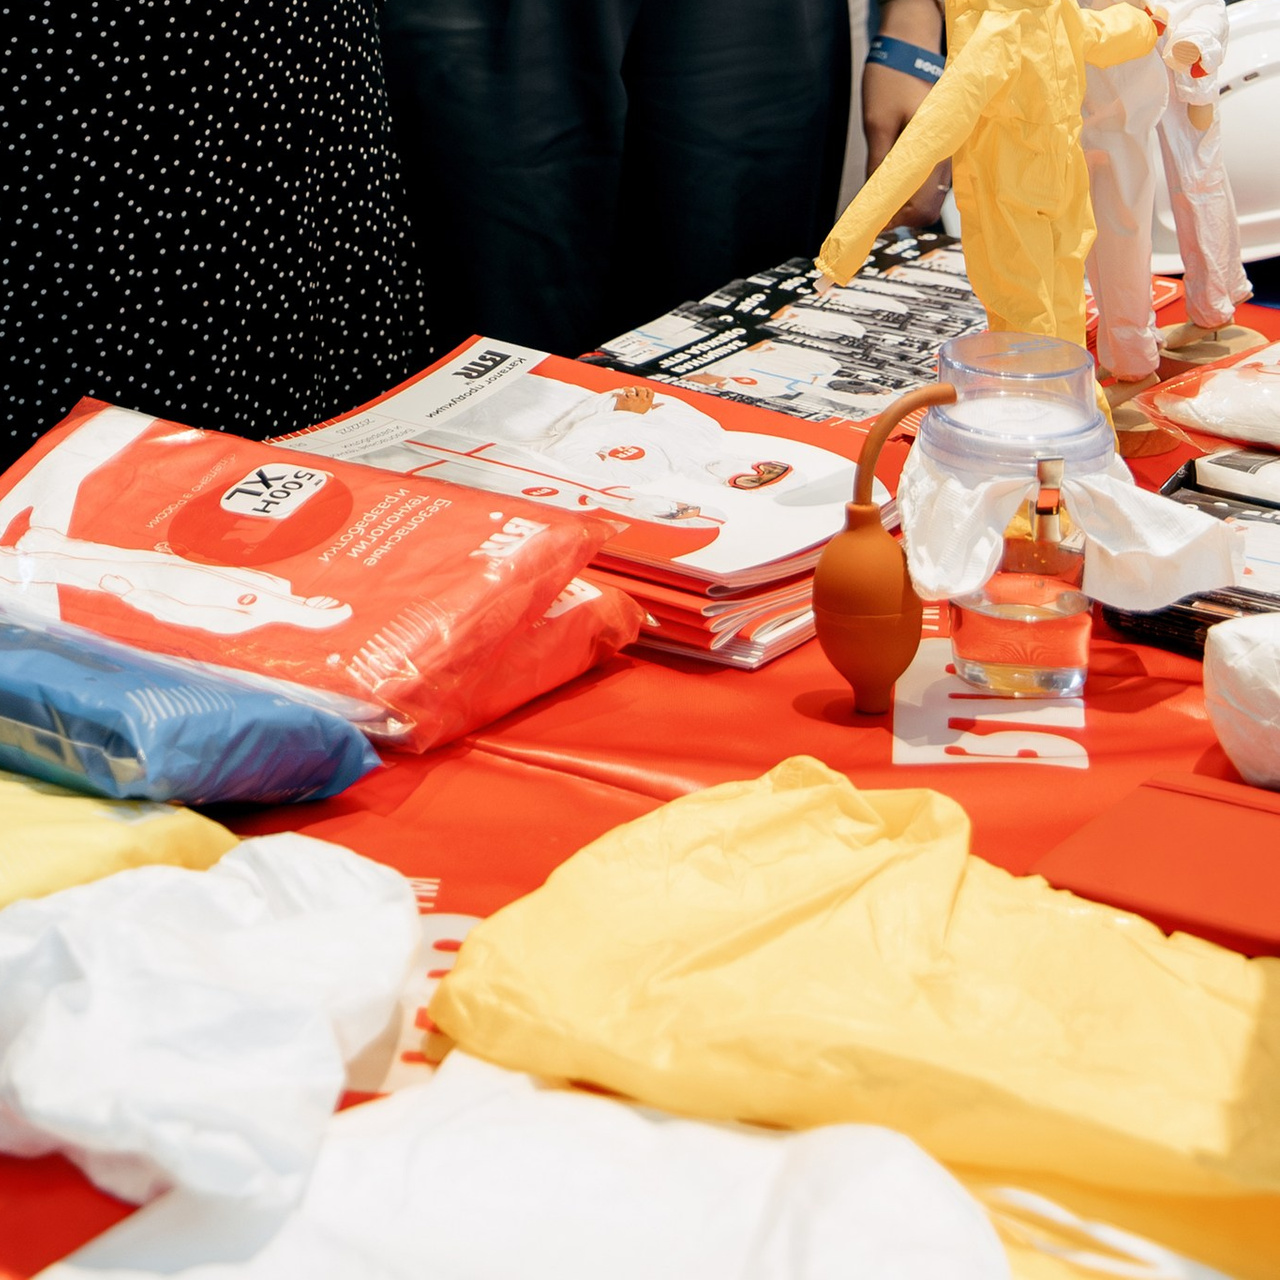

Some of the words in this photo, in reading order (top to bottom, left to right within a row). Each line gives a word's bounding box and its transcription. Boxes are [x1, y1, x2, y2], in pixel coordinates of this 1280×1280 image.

[484, 356, 528, 385] Каталог
[425, 382, 486, 420] продукции
[225, 468, 288, 501] XL
[317, 489, 401, 564] разработки
[346, 493, 430, 560] технологии
[363, 497, 453, 567] Безопасные
